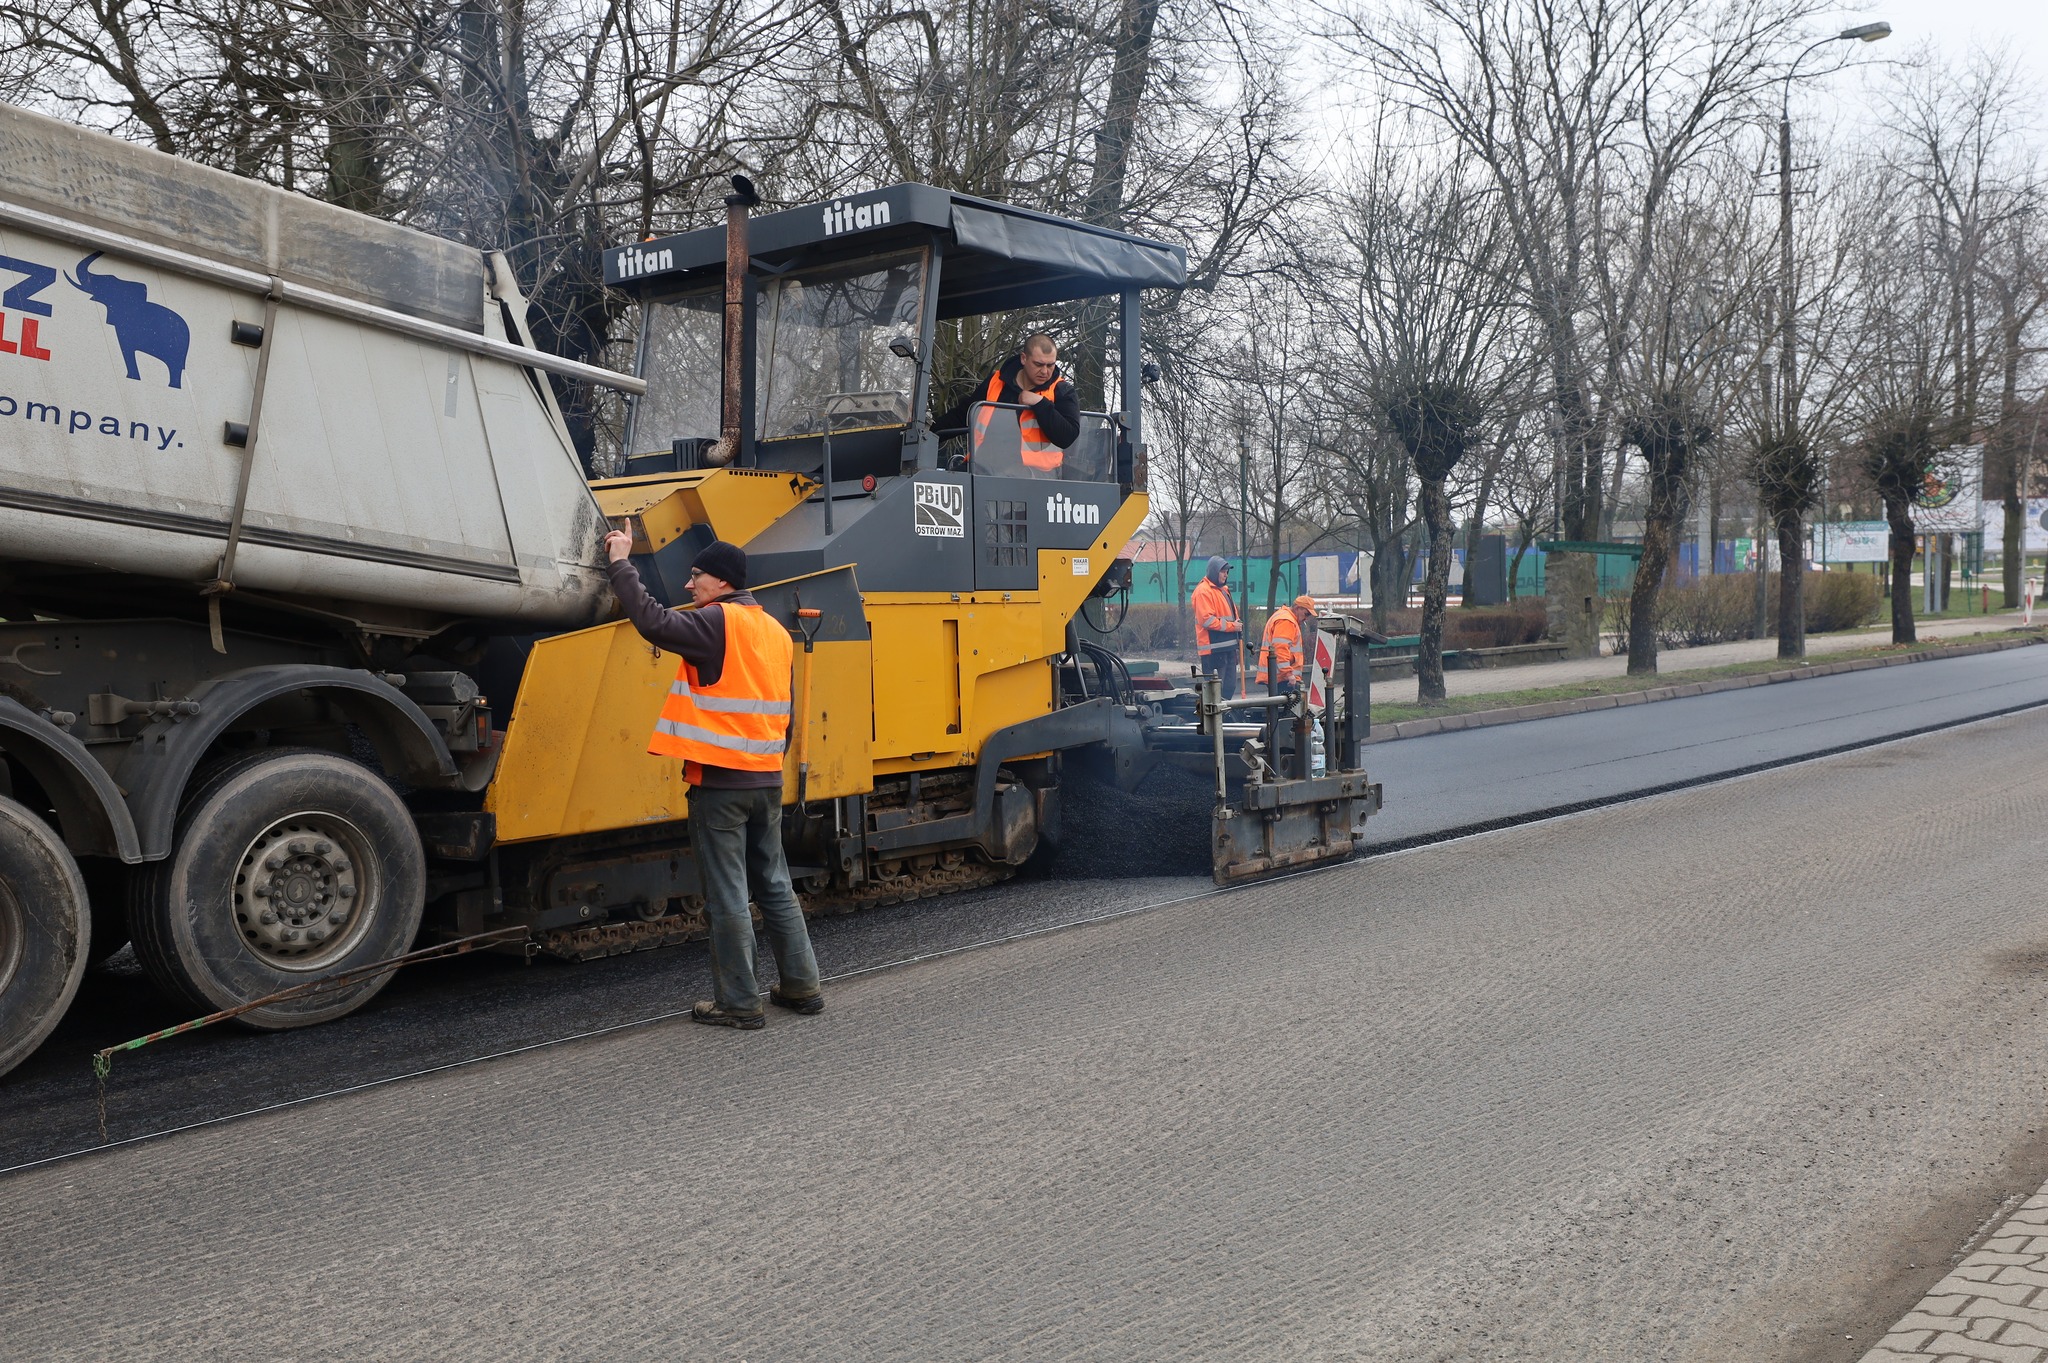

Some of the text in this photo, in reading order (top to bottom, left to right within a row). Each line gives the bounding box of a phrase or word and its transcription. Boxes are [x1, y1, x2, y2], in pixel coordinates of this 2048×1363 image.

[822, 200, 891, 236] titan
[617, 246, 674, 279] titan
[915, 484, 963, 516] PBiUD
[1047, 492, 1100, 524] titan
